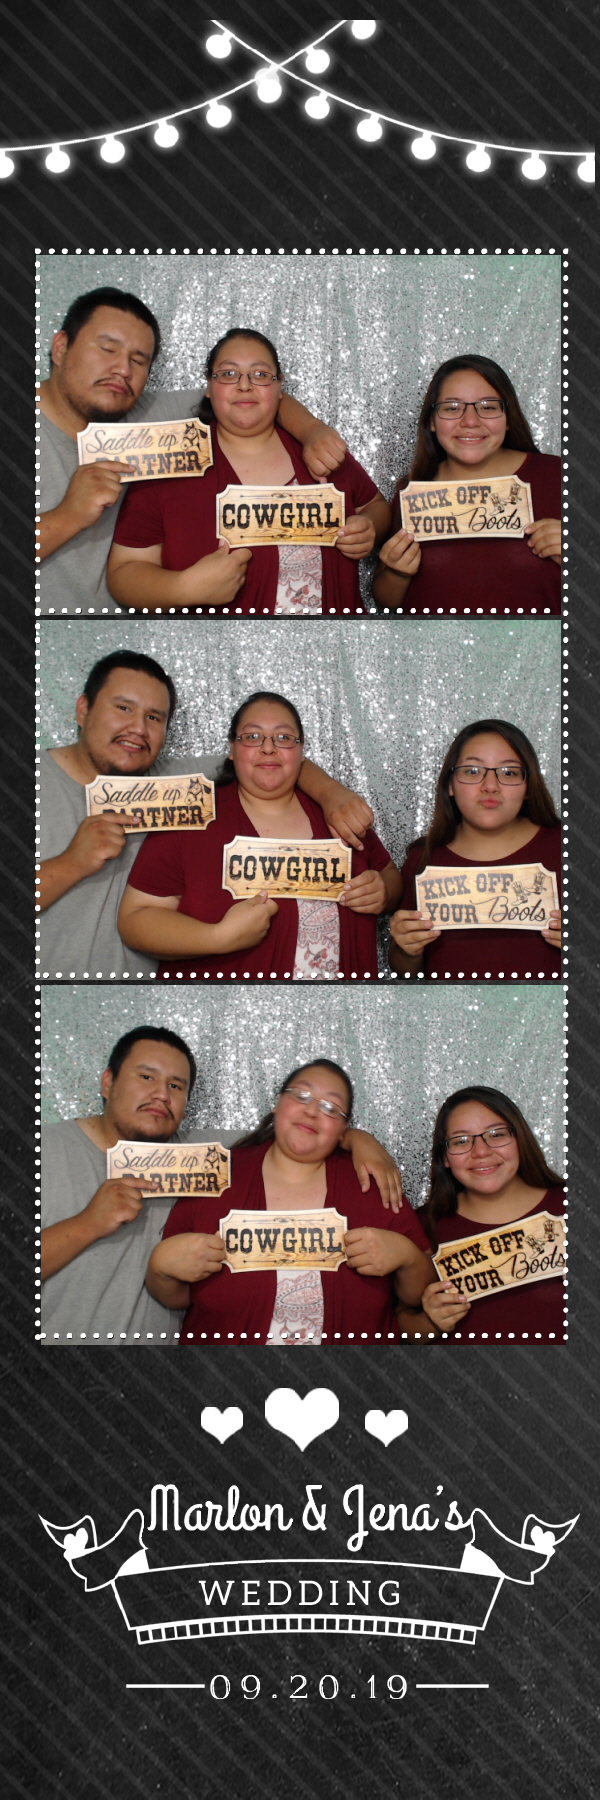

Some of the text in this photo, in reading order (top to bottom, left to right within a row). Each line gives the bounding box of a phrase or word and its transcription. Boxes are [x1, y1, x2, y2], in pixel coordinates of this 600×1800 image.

[86, 428, 178, 455] Saddle up
[95, 451, 201, 477] RTNER
[404, 486, 492, 514] KICK OFF
[222, 502, 340, 529] COWGIRL
[409, 507, 522, 534] YOUR Boots
[93, 782, 183, 807] Saddle up
[102, 805, 204, 828] RTNER
[229, 854, 346, 883] COWGIRL
[421, 873, 514, 900] KICK OFF
[425, 895, 547, 924] YOUR Boots
[113, 1147, 200, 1172] Saddle up
[122, 1173, 220, 1193] RTNER
[225, 1227, 342, 1254] COWGIRL
[438, 1229, 525, 1277] KICK OFF
[450, 1245, 566, 1295] YOUR Boots
